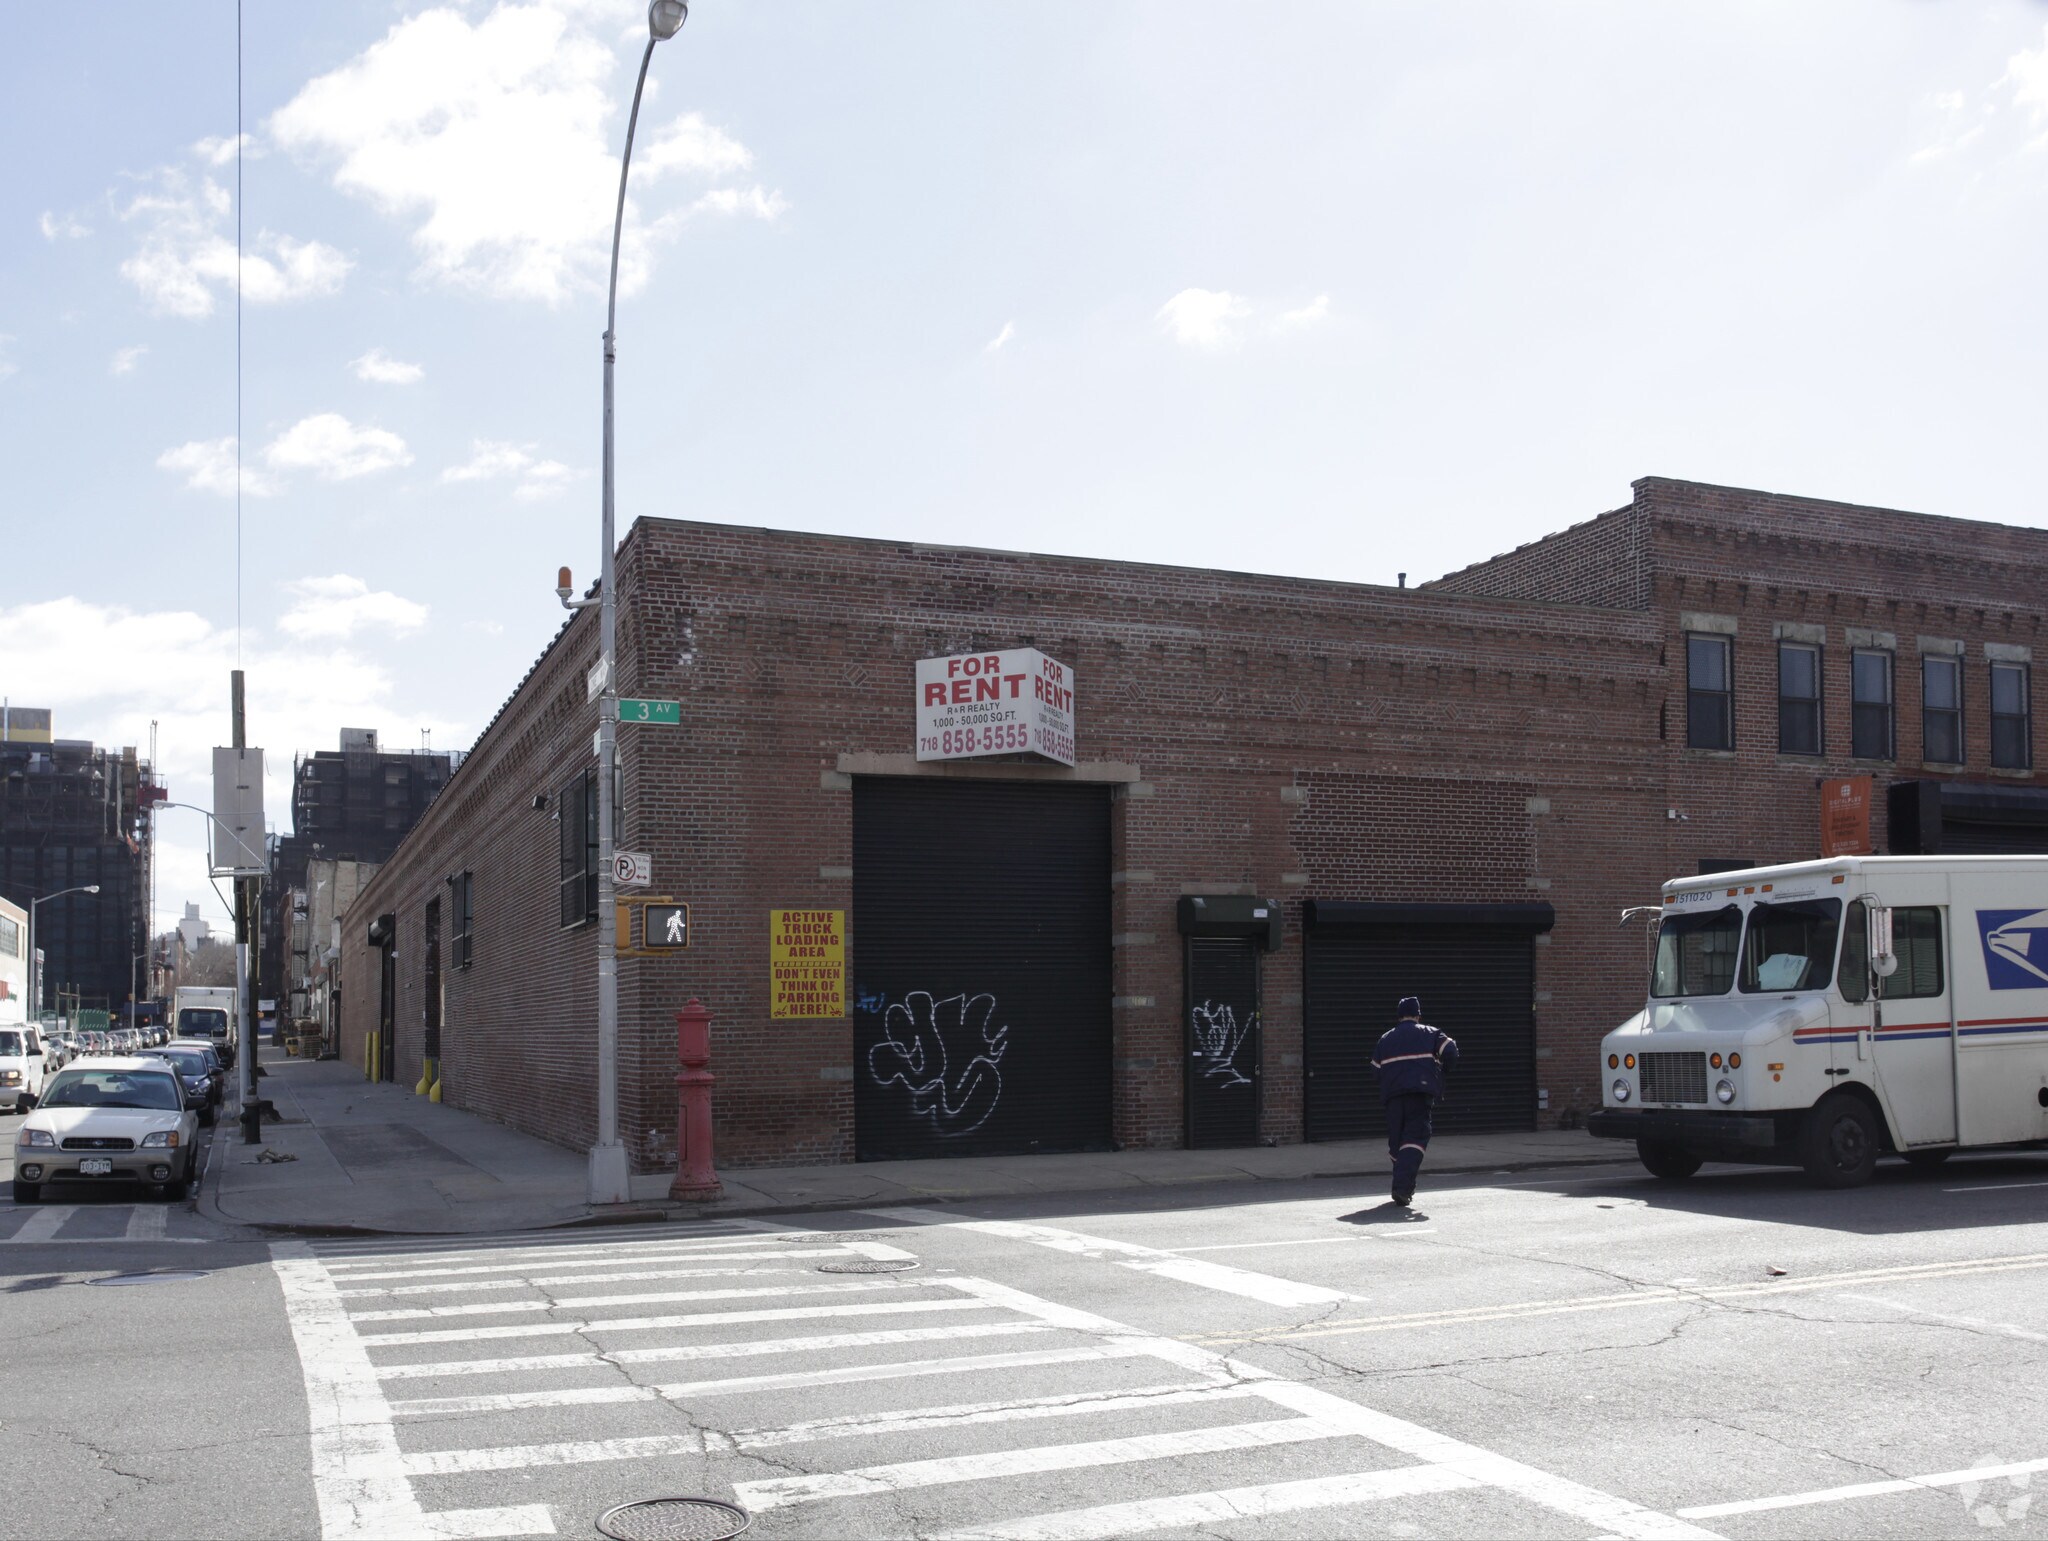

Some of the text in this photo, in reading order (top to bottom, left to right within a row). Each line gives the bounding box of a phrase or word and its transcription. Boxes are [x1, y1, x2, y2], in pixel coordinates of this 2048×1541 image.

[948, 656, 1000, 678] FOR
[1043, 658, 1063, 685] FOR
[925, 673, 1026, 707] RENT
[1035, 674, 1072, 713] RENT
[638, 702, 670, 720] 3 AV
[967, 702, 1000, 713] REALTY
[933, 717, 954, 729] 1,000
[961, 713, 988, 726] 50,000
[990, 711, 1017, 723] SQ.FT.
[921, 723, 1028, 755] 718 858-5555
[1042, 727, 1073, 762] 858-5555
[782, 912, 834, 922] ACTIVE
[783, 924, 832, 934] TRUCK
[776, 935, 839, 945] LOADING
[789, 947, 825, 957] AREA
[775, 968, 840, 979] DON'T EVEN
[781, 981, 835, 991] THINK OF
[778, 992, 839, 1003] PARKING
[790, 1004, 827, 1015] HERE!
